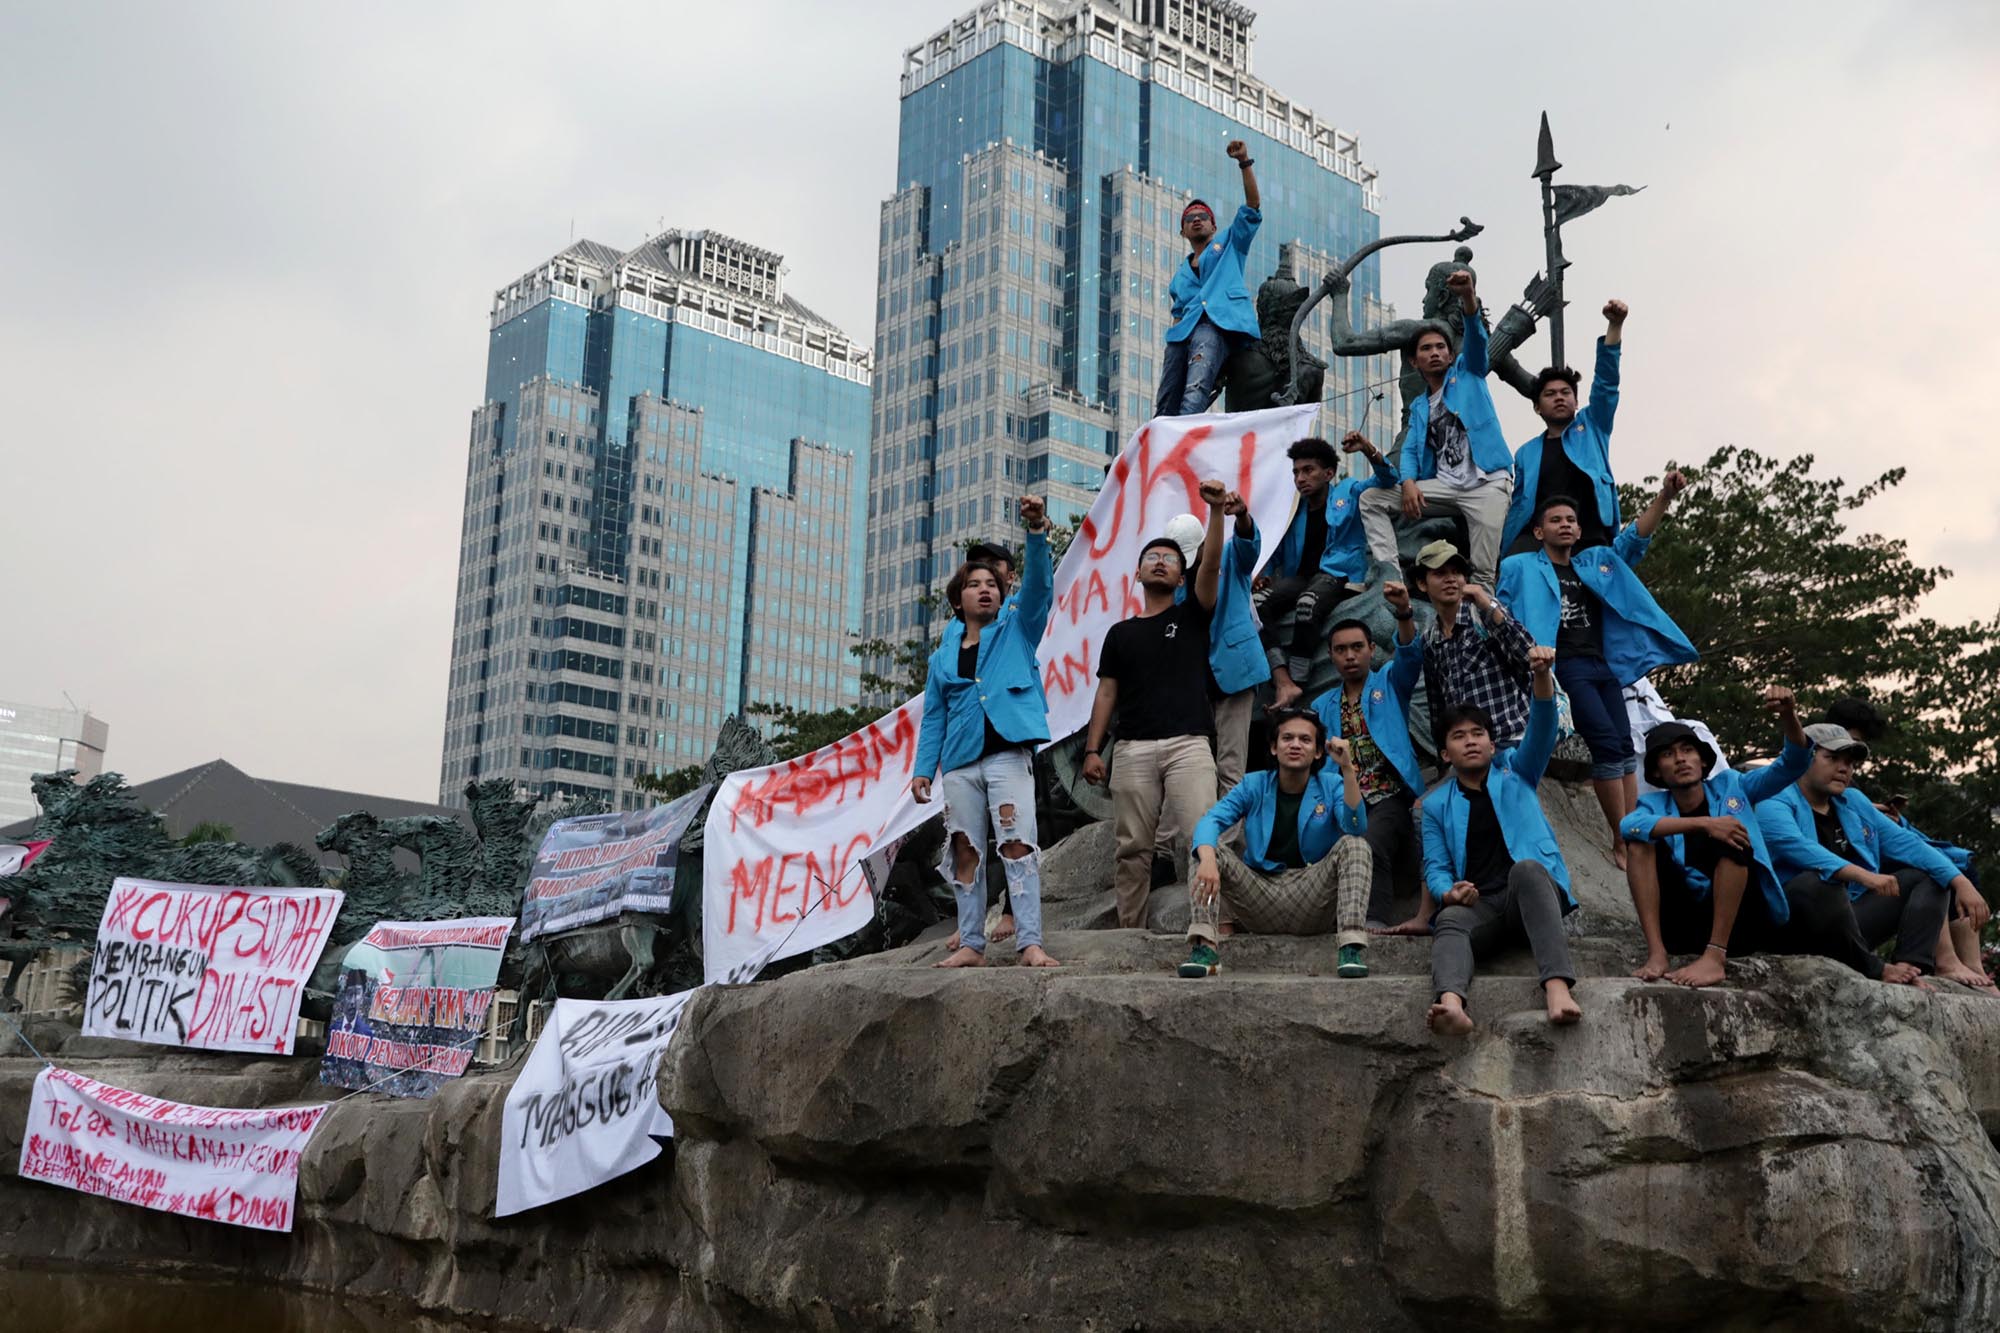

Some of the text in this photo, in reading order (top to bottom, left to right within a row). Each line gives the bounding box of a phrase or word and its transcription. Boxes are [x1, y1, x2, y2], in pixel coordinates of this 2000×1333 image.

[1082, 425, 1256, 560] UKI
[92, 940, 211, 980] MEMBANGUN
[233, 896, 336, 973] SUDAH
[89, 974, 195, 1045] POLITIK
